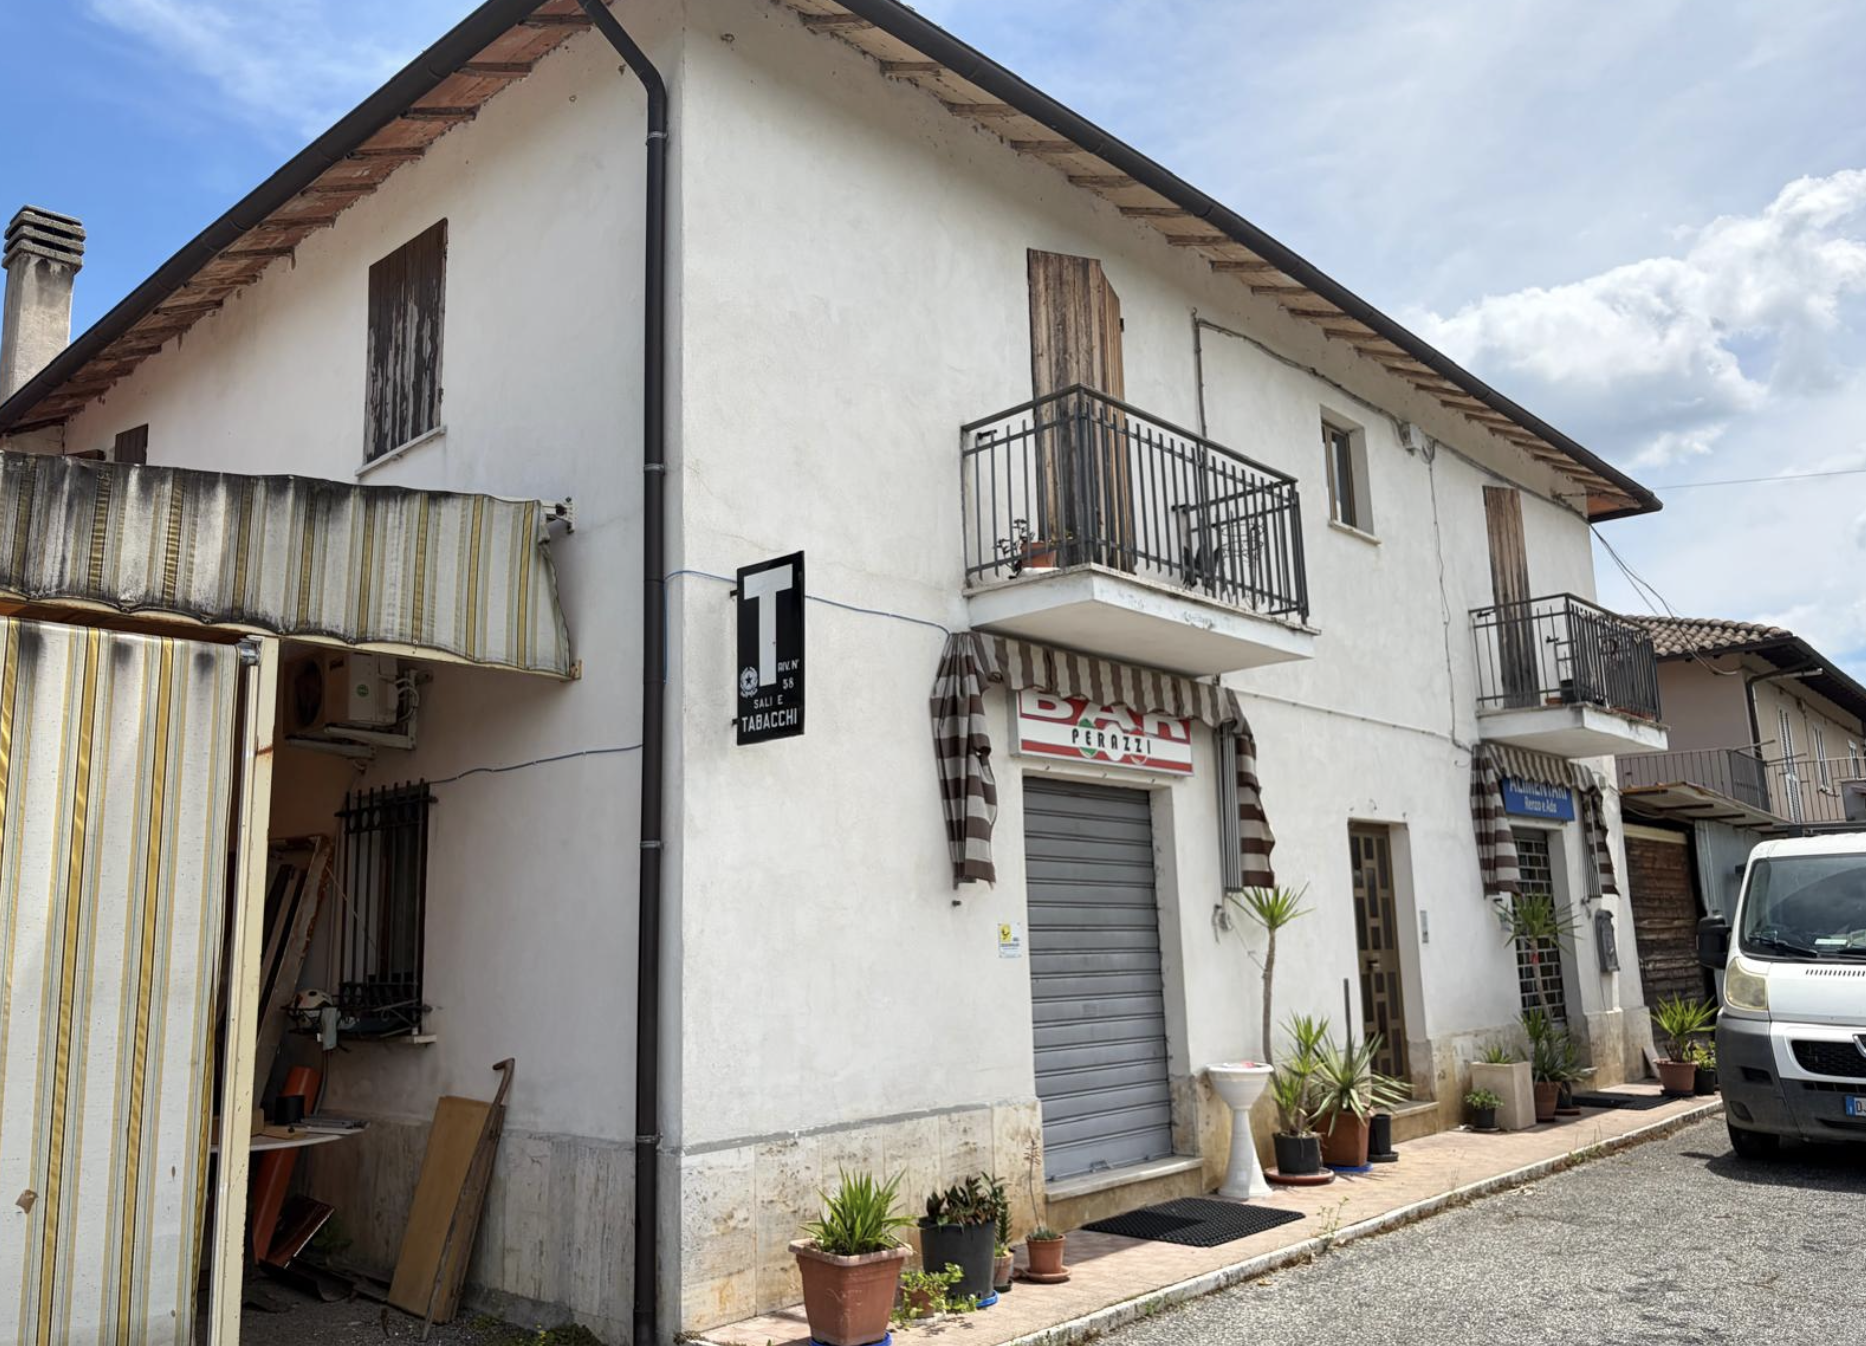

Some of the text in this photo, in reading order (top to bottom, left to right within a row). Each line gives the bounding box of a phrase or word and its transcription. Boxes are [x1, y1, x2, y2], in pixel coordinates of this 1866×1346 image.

[744, 563, 793, 687] T
[753, 694, 784, 709] SALI E
[741, 707, 798, 732] TABACCHI
[1072, 728, 1151, 754] PERAZZI
